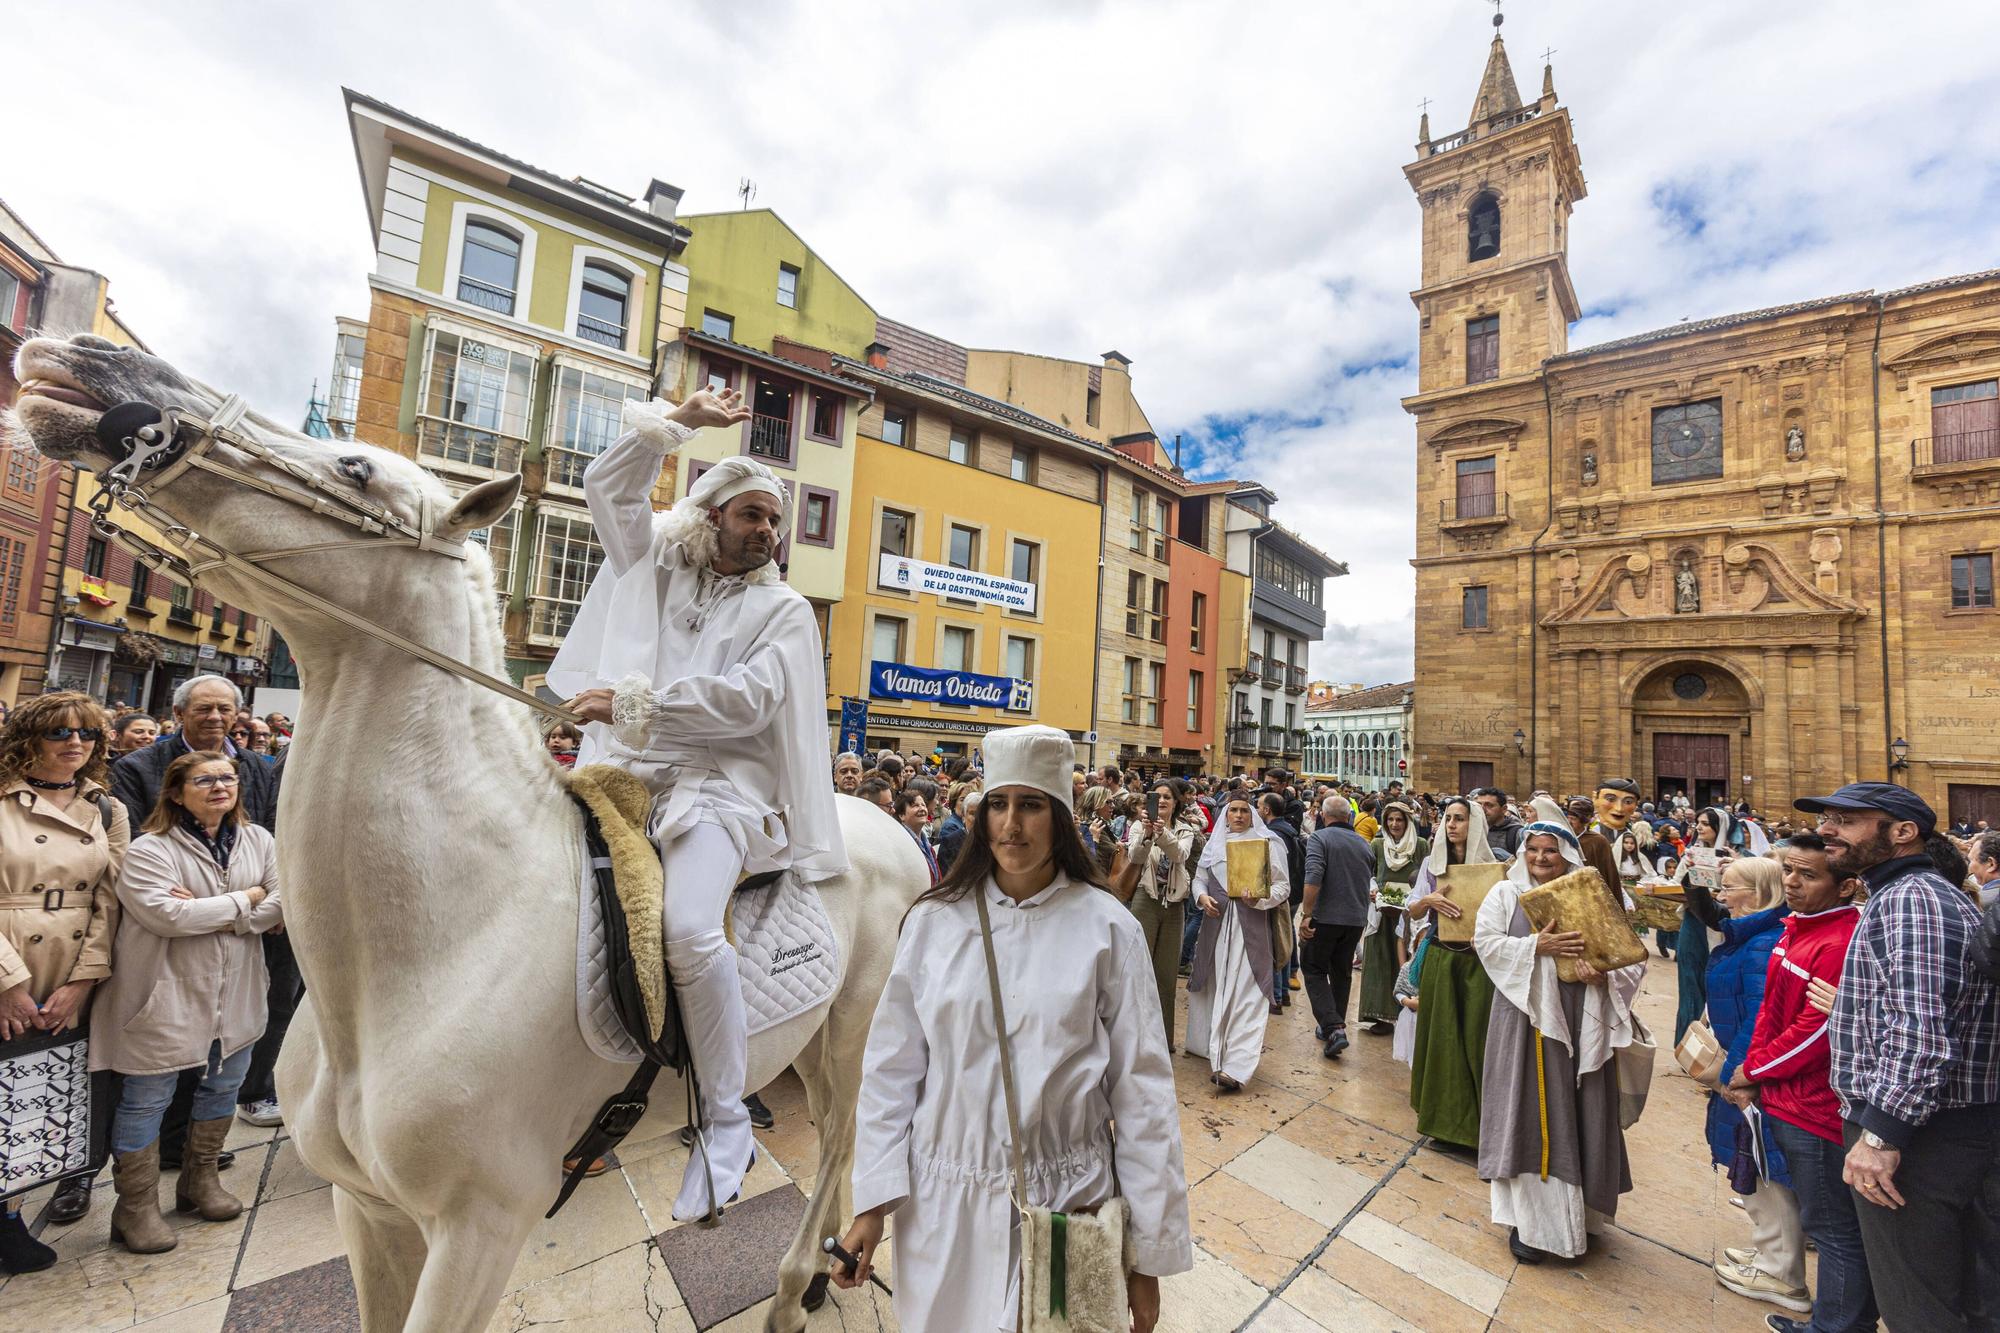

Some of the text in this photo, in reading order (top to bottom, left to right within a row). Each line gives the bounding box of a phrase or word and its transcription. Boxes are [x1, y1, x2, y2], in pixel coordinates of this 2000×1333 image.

[467, 341, 485, 353] Yo
[924, 567, 1028, 595] OVIEDO CAPITAL ESPAÑOLA
[924, 580, 1025, 606] DE LA GASTRONOMÍA 2024
[881, 669, 1003, 702] Vamos Oviedo
[867, 716, 890, 725] ENTRO
[890, 717, 900, 725] DE
[976, 725, 987, 733] DEL
[771, 942, 815, 965] Dressage
